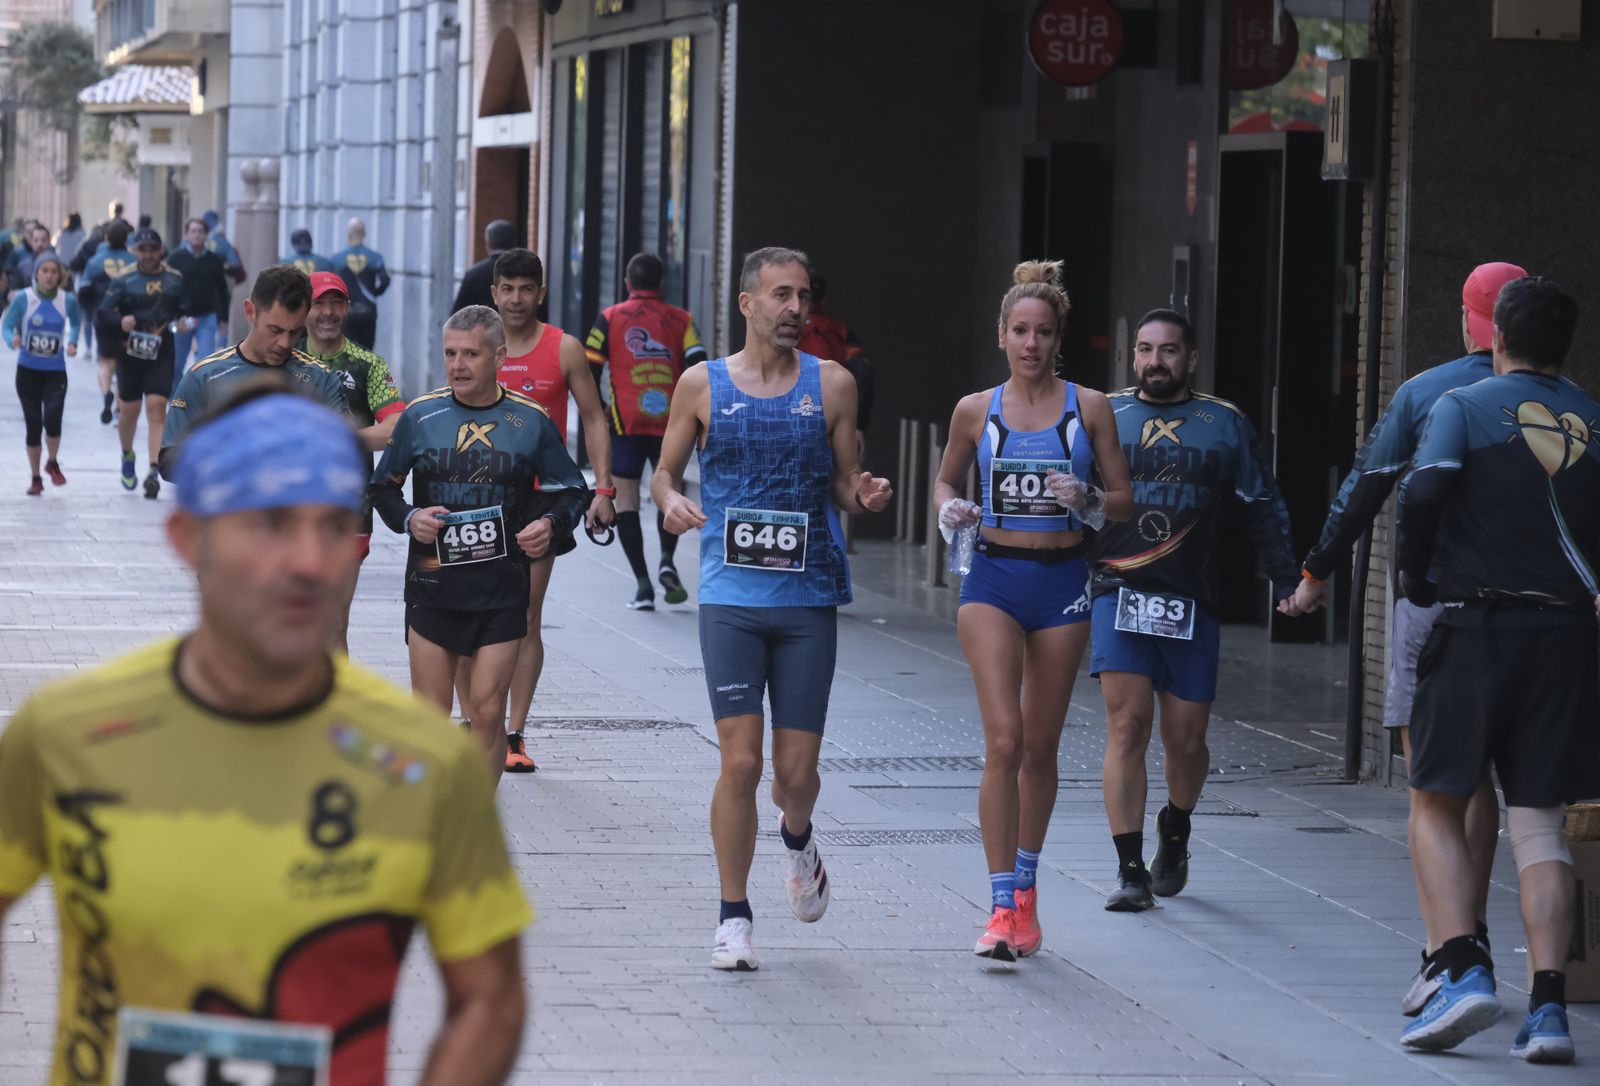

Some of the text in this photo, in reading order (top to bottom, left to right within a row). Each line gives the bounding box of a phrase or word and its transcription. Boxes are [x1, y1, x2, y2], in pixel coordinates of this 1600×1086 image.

[1040, 6, 1109, 42] caja
[31, 336, 57, 349] 301
[503, 412, 525, 429] SIG
[1193, 409, 1216, 424] SIG
[456, 420, 498, 455] IX
[1140, 417, 1185, 450] IX
[1000, 462, 1069, 472] SUBIDA ERMITAS
[470, 509, 500, 521] ERMITAS
[736, 512, 805, 525] SUBIDA ERMITAS
[443, 521, 497, 547] 468
[734, 523, 797, 551] 646
[1127, 593, 1185, 621] 363
[309, 778, 358, 852] 8
